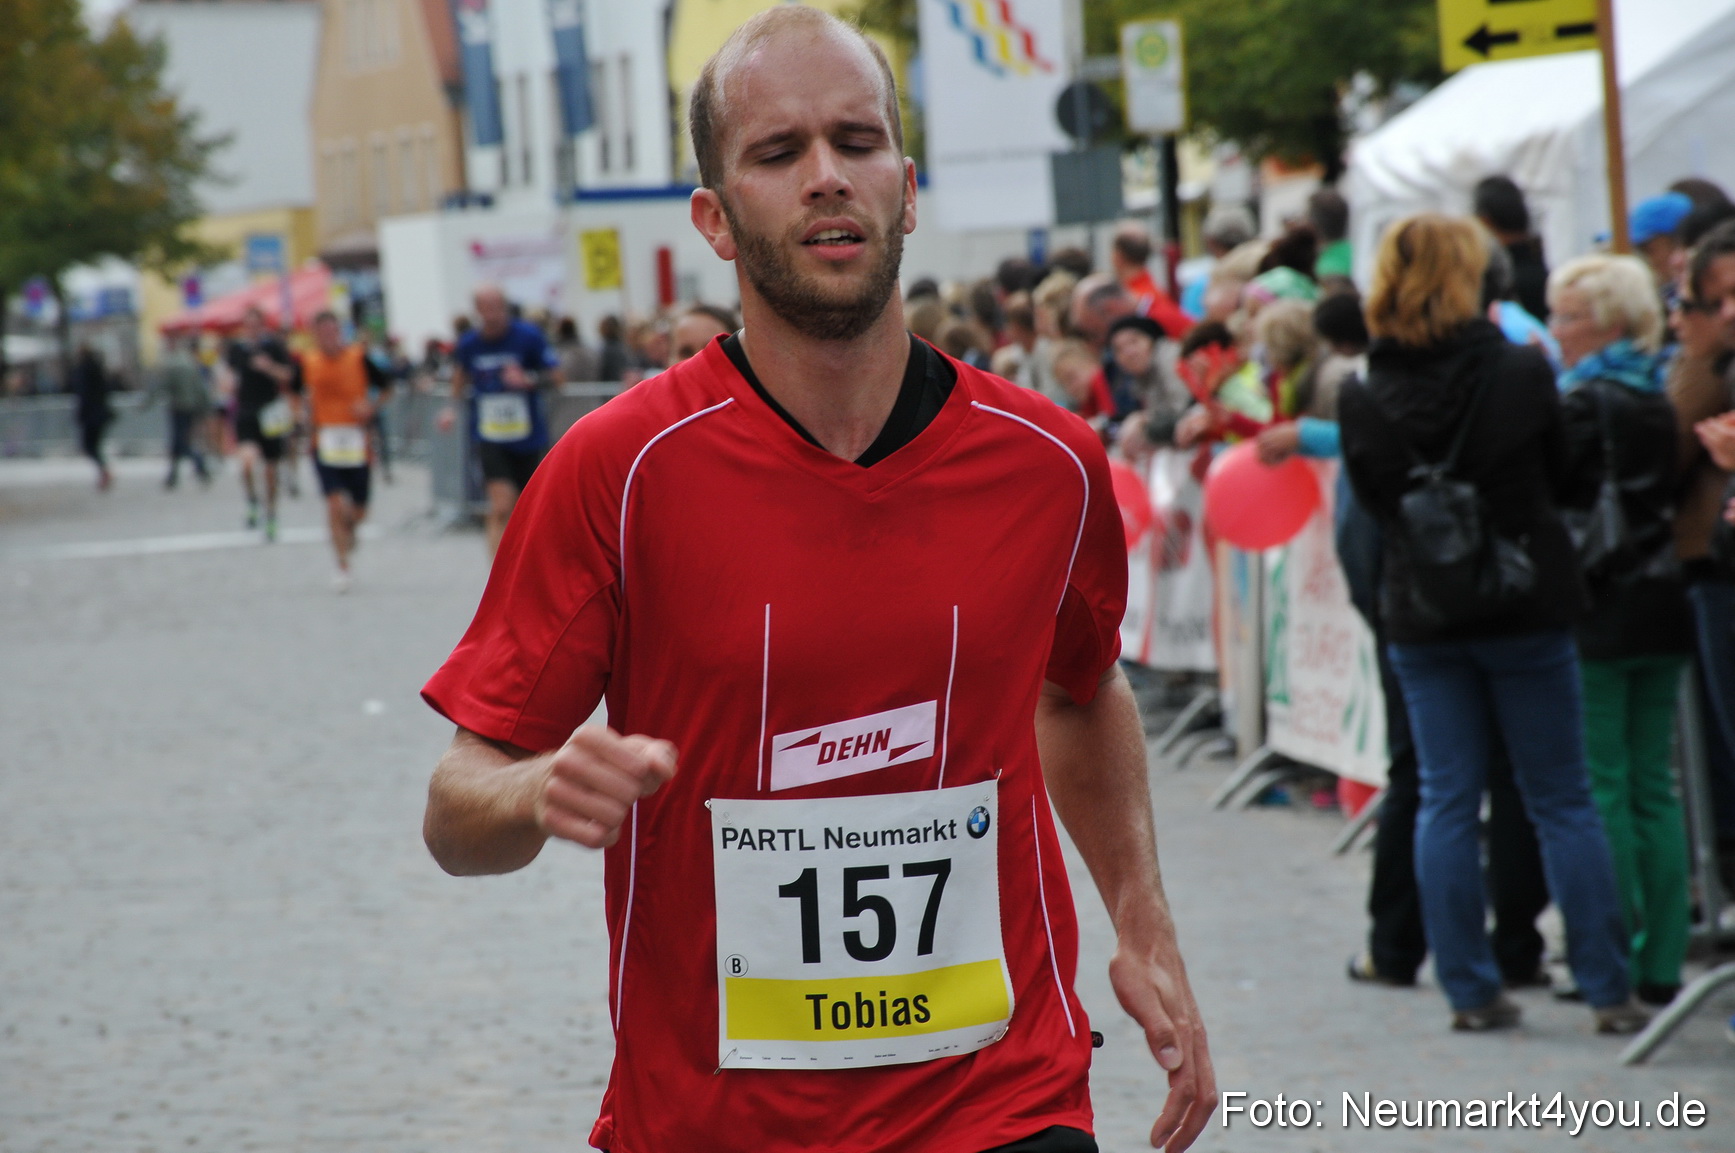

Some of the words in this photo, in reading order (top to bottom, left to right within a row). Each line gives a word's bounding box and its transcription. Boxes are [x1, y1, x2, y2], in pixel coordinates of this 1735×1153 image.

[817, 727, 892, 766] DEHN
[721, 826, 816, 852] PARTL
[823, 818, 957, 850] Neumarkt
[778, 857, 952, 964] 157
[731, 957, 742, 975] B
[805, 990, 931, 1031] Tobias
